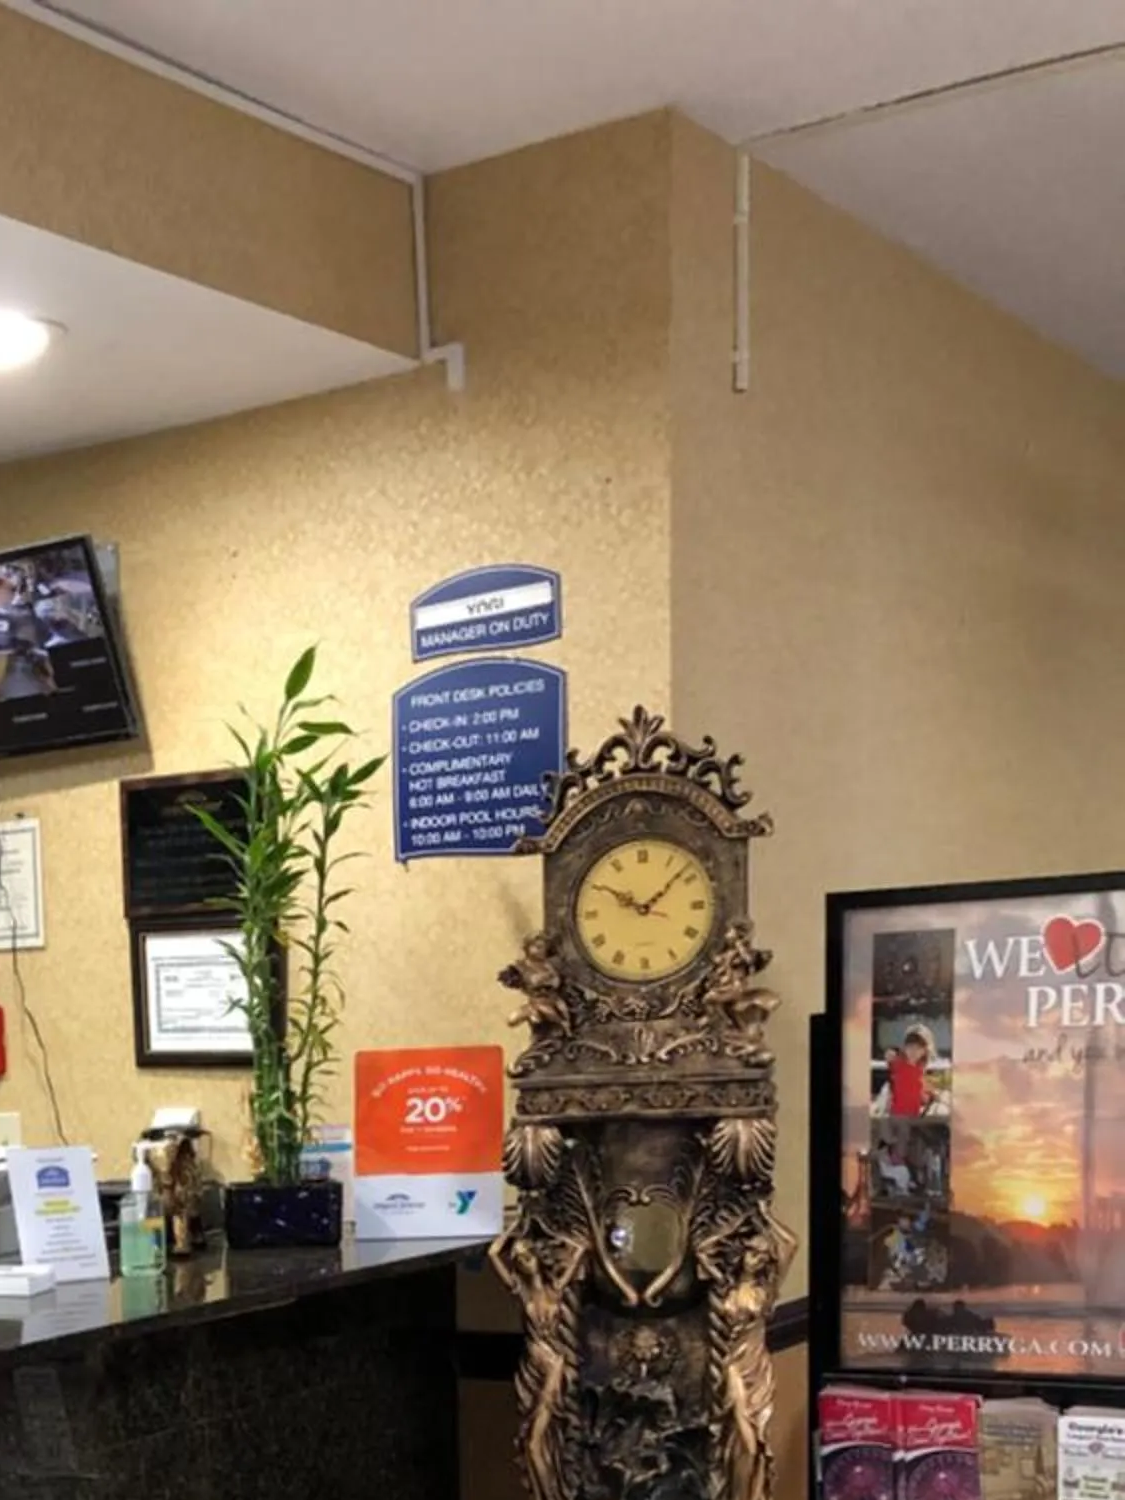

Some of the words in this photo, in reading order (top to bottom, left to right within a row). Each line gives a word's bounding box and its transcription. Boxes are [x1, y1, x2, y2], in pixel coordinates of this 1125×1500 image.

[420, 623, 487, 647] MANAGER
[489, 620, 510, 636] ON
[513, 612, 550, 631] DUTY
[411, 690, 450, 708] FRONT
[453, 686, 485, 702] DESK
[488, 678, 545, 698] POLICIES
[500, 708, 519, 721] PM
[486, 730, 517, 745] 11:00
[520, 727, 539, 740] AM
[409, 777, 433, 792] HOT
[435, 770, 506, 790] BREAKFAST
[436, 792, 455, 805] AM
[491, 787, 511, 800] AM
[513, 782, 550, 799] DAILY
[410, 812, 457, 830] INDOOR
[459, 810, 491, 825] POOL
[443, 830, 462, 843] AM
[964, 935, 1047, 980] WE
[857, 1331, 1112, 1358] WWW.PERRYGA.COM
